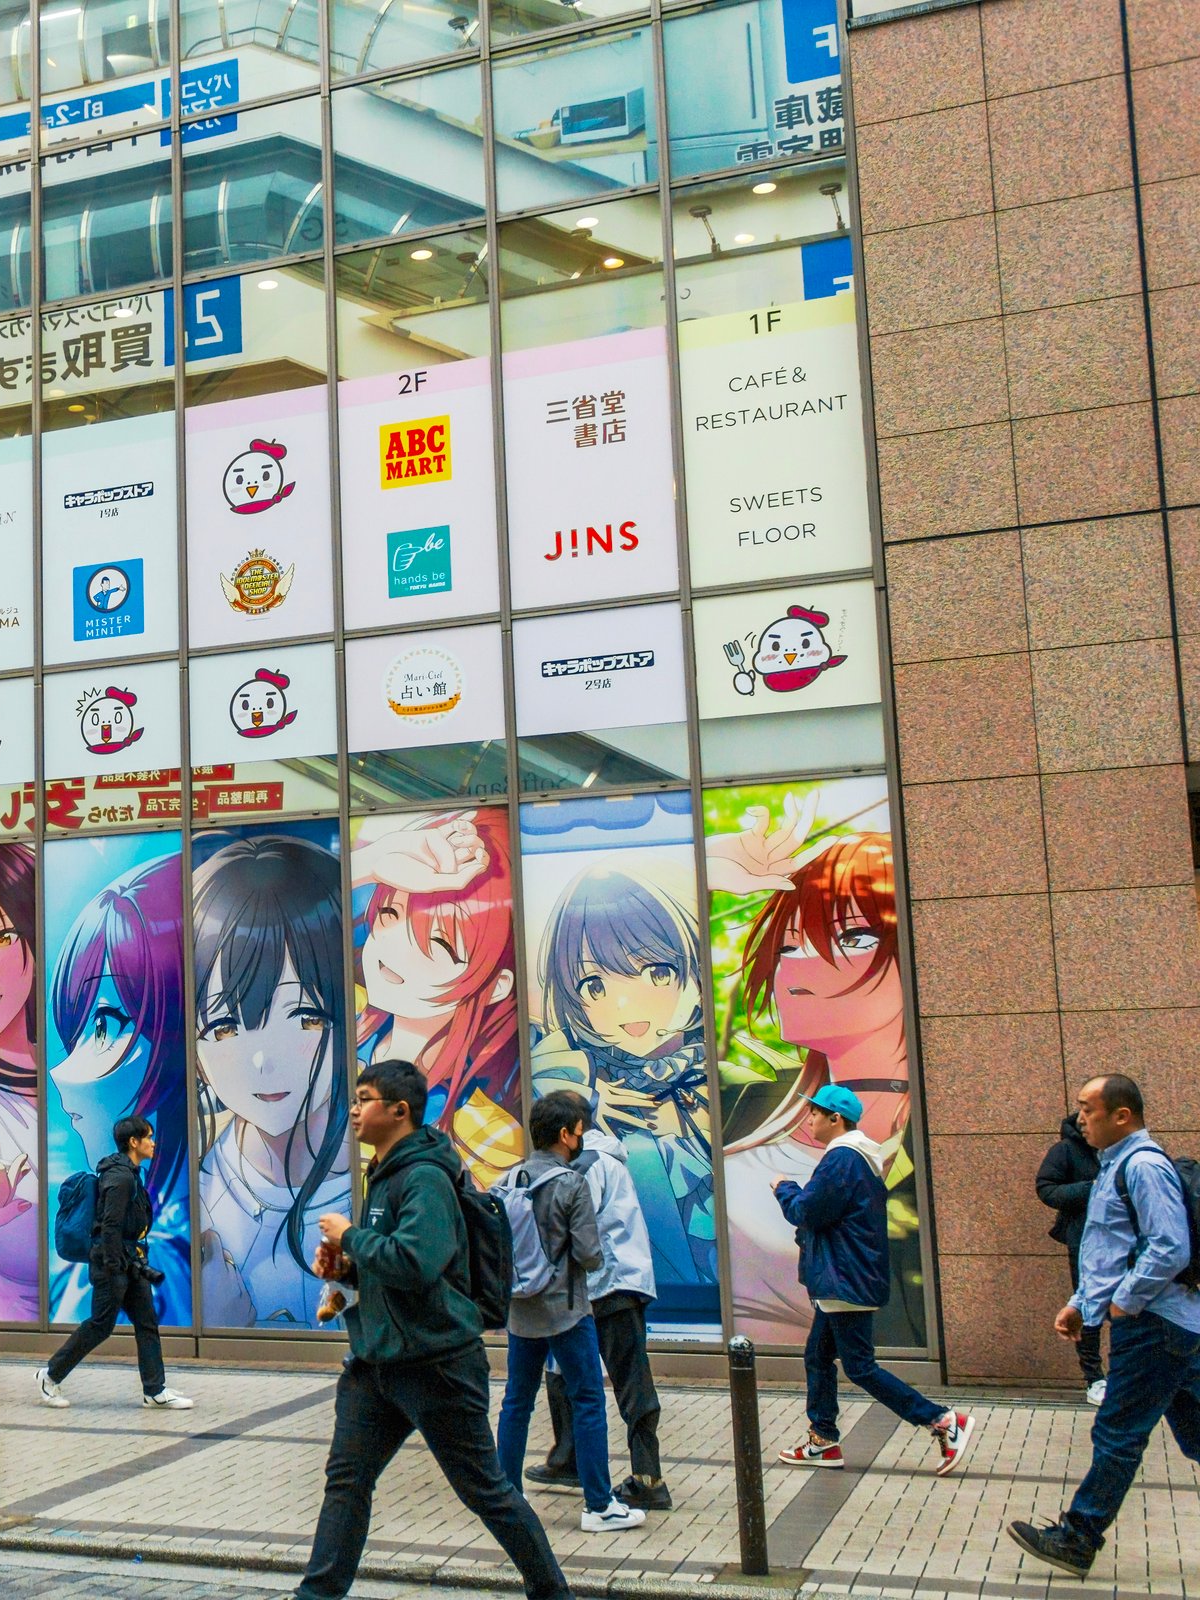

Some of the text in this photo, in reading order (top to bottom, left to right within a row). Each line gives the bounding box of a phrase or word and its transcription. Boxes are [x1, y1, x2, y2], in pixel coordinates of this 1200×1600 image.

[749, 309, 782, 335] 1F
[398, 371, 428, 395] 2F
[728, 366, 808, 393] CAFÉ &
[546, 389, 626, 424] 三省堂
[696, 394, 848, 432] RESTAURANT
[385, 424, 445, 460] ABC
[573, 418, 627, 449] 書店
[386, 454, 446, 481] MART
[65, 482, 154, 508] キャラポップストア
[730, 486, 824, 514] SWEETS
[99, 507, 119, 519] 1号店
[738, 522, 817, 548] FLOOR
[394, 571, 446, 586] hands be
[85, 614, 132, 628] MISTER
[86, 624, 124, 638] MINIT
[542, 650, 654, 677] キャラポップストア
[401, 681, 447, 700] 占い館
[584, 678, 612, 691] 2号店
